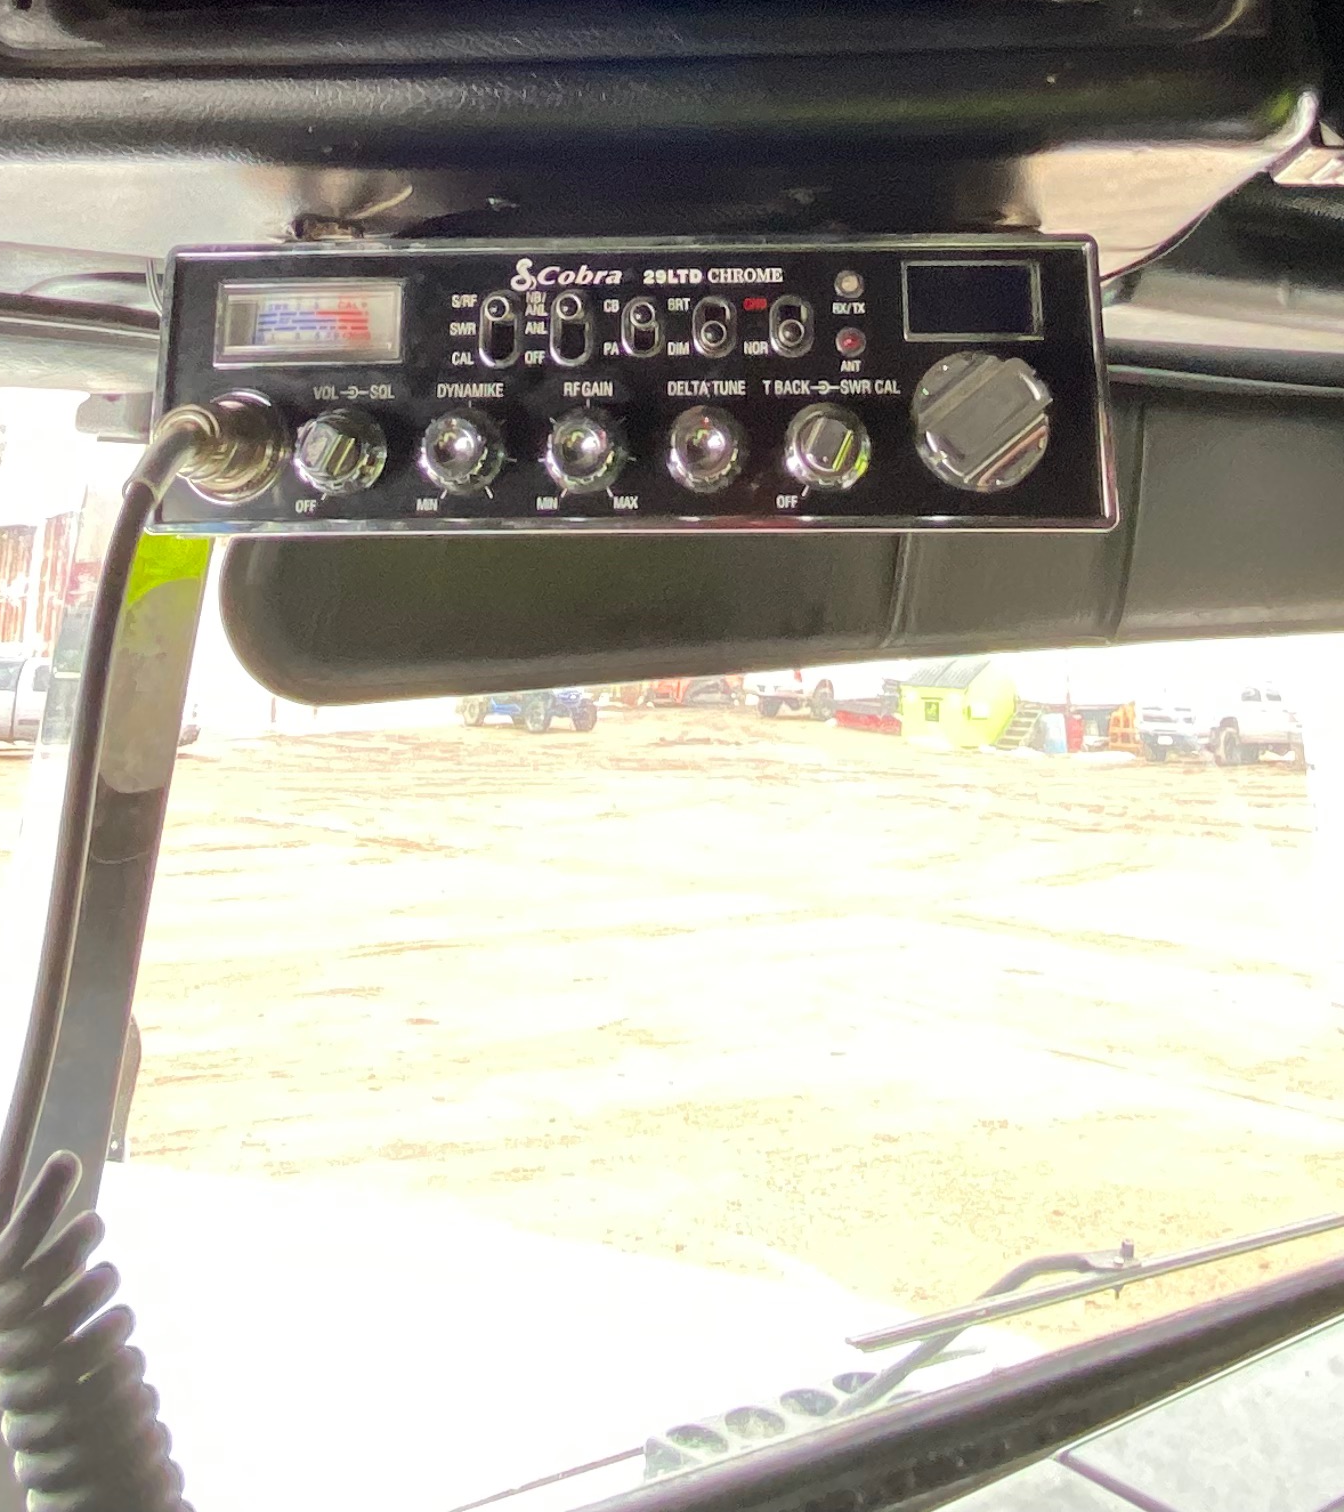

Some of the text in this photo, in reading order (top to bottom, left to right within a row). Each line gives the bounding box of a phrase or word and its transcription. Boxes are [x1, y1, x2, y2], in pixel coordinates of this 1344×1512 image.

[536, 265, 784, 285] Cobra 29LTD CHROME
[451, 294, 478, 308] S/RF
[603, 299, 619, 313] CB
[668, 298, 690, 312] BRT
[832, 302, 866, 315] RX/TX
[449, 322, 477, 336] SWR
[525, 322, 548, 335] ANL
[603, 341, 620, 356] PA
[667, 341, 690, 356] DIM
[743, 340, 769, 355] NOR
[451, 352, 474, 366] CAL
[524, 350, 546, 365] OFF
[840, 360, 862, 373] ANT
[313, 387, 339, 400] VOL
[436, 382, 504, 398] DYNAMIKE
[563, 380, 613, 397] RF GAIN
[667, 379, 746, 396] DELTA TUNE
[763, 379, 900, 395] T BACK SWR CAL
[295, 499, 317, 514] OFF
[416, 497, 438, 512] MIN
[537, 496, 558, 511] MIN
[614, 495, 639, 510] MAX
[776, 494, 798, 509] OFF
